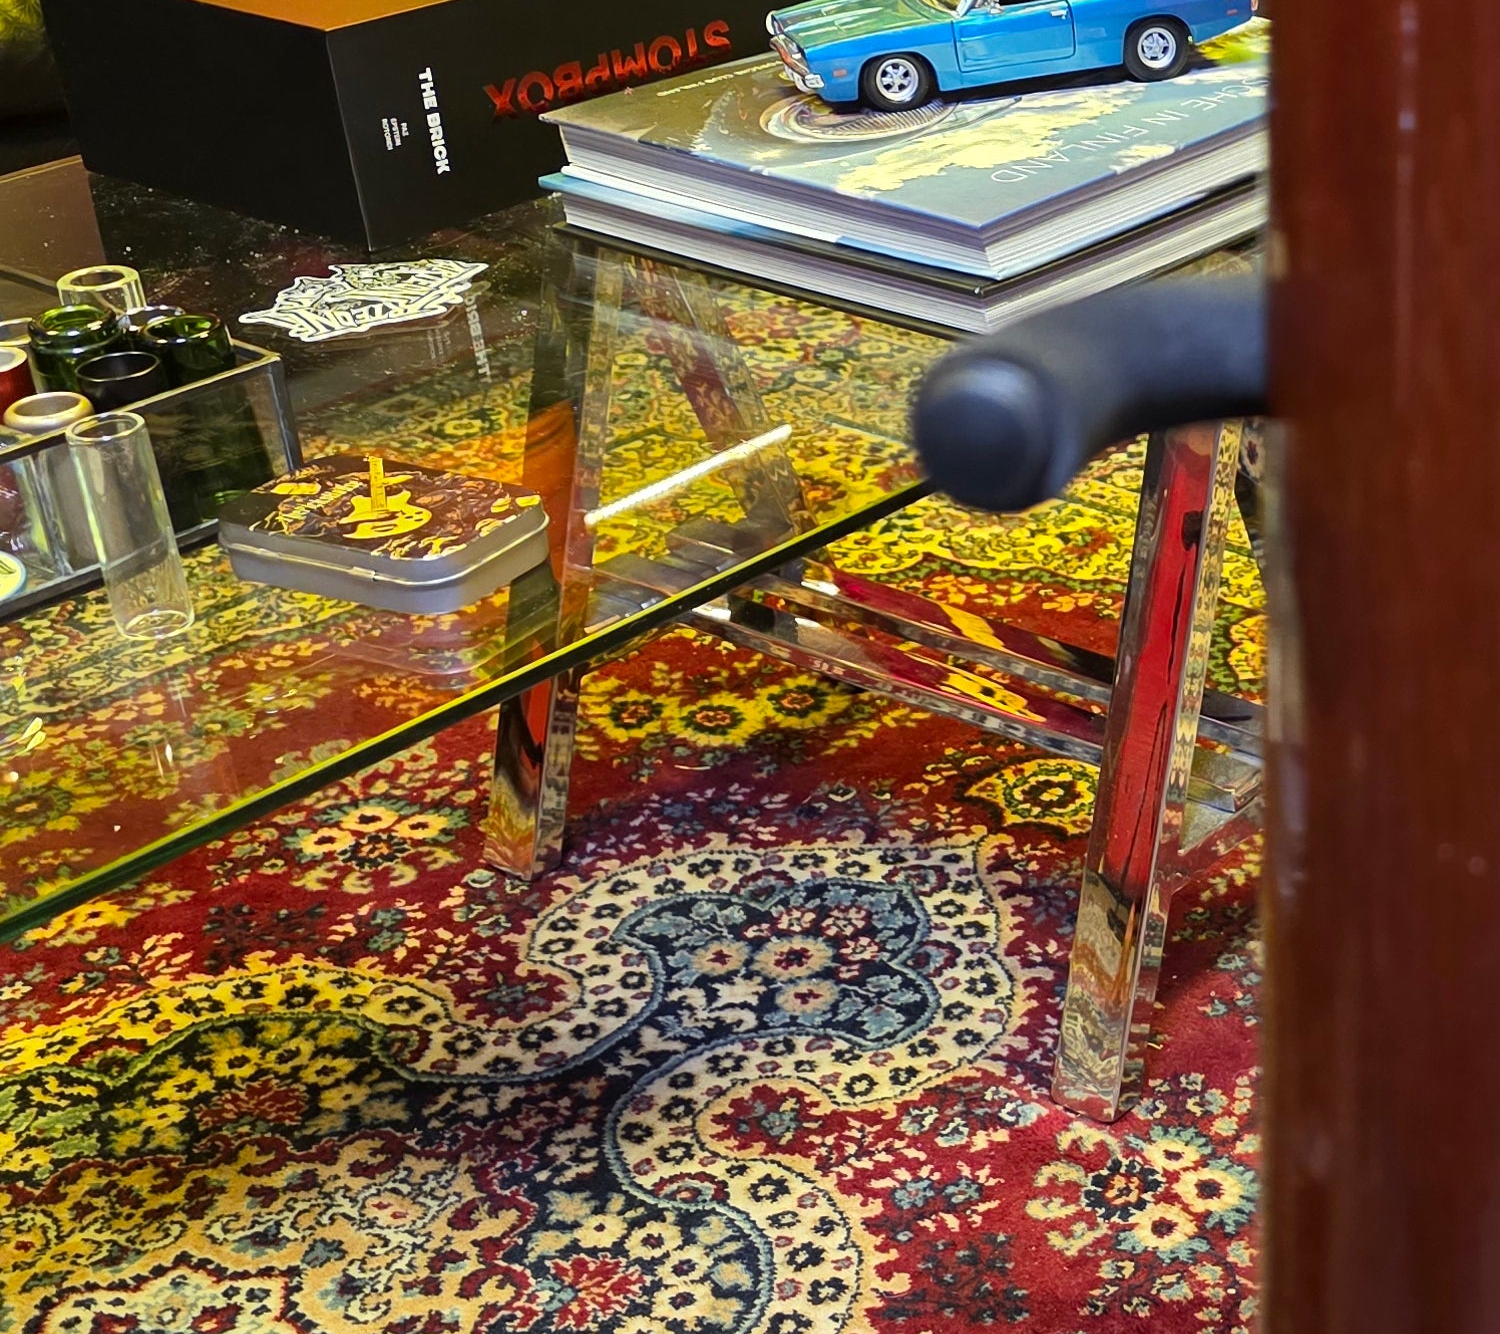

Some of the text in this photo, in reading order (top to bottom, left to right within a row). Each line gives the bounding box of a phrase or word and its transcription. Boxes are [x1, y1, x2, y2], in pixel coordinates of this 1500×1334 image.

[418, 67, 451, 175] THE BRICK
[483, 19, 731, 118] STOMPBOX
[990, 78, 1271, 183] SCHE IN FINLAND
